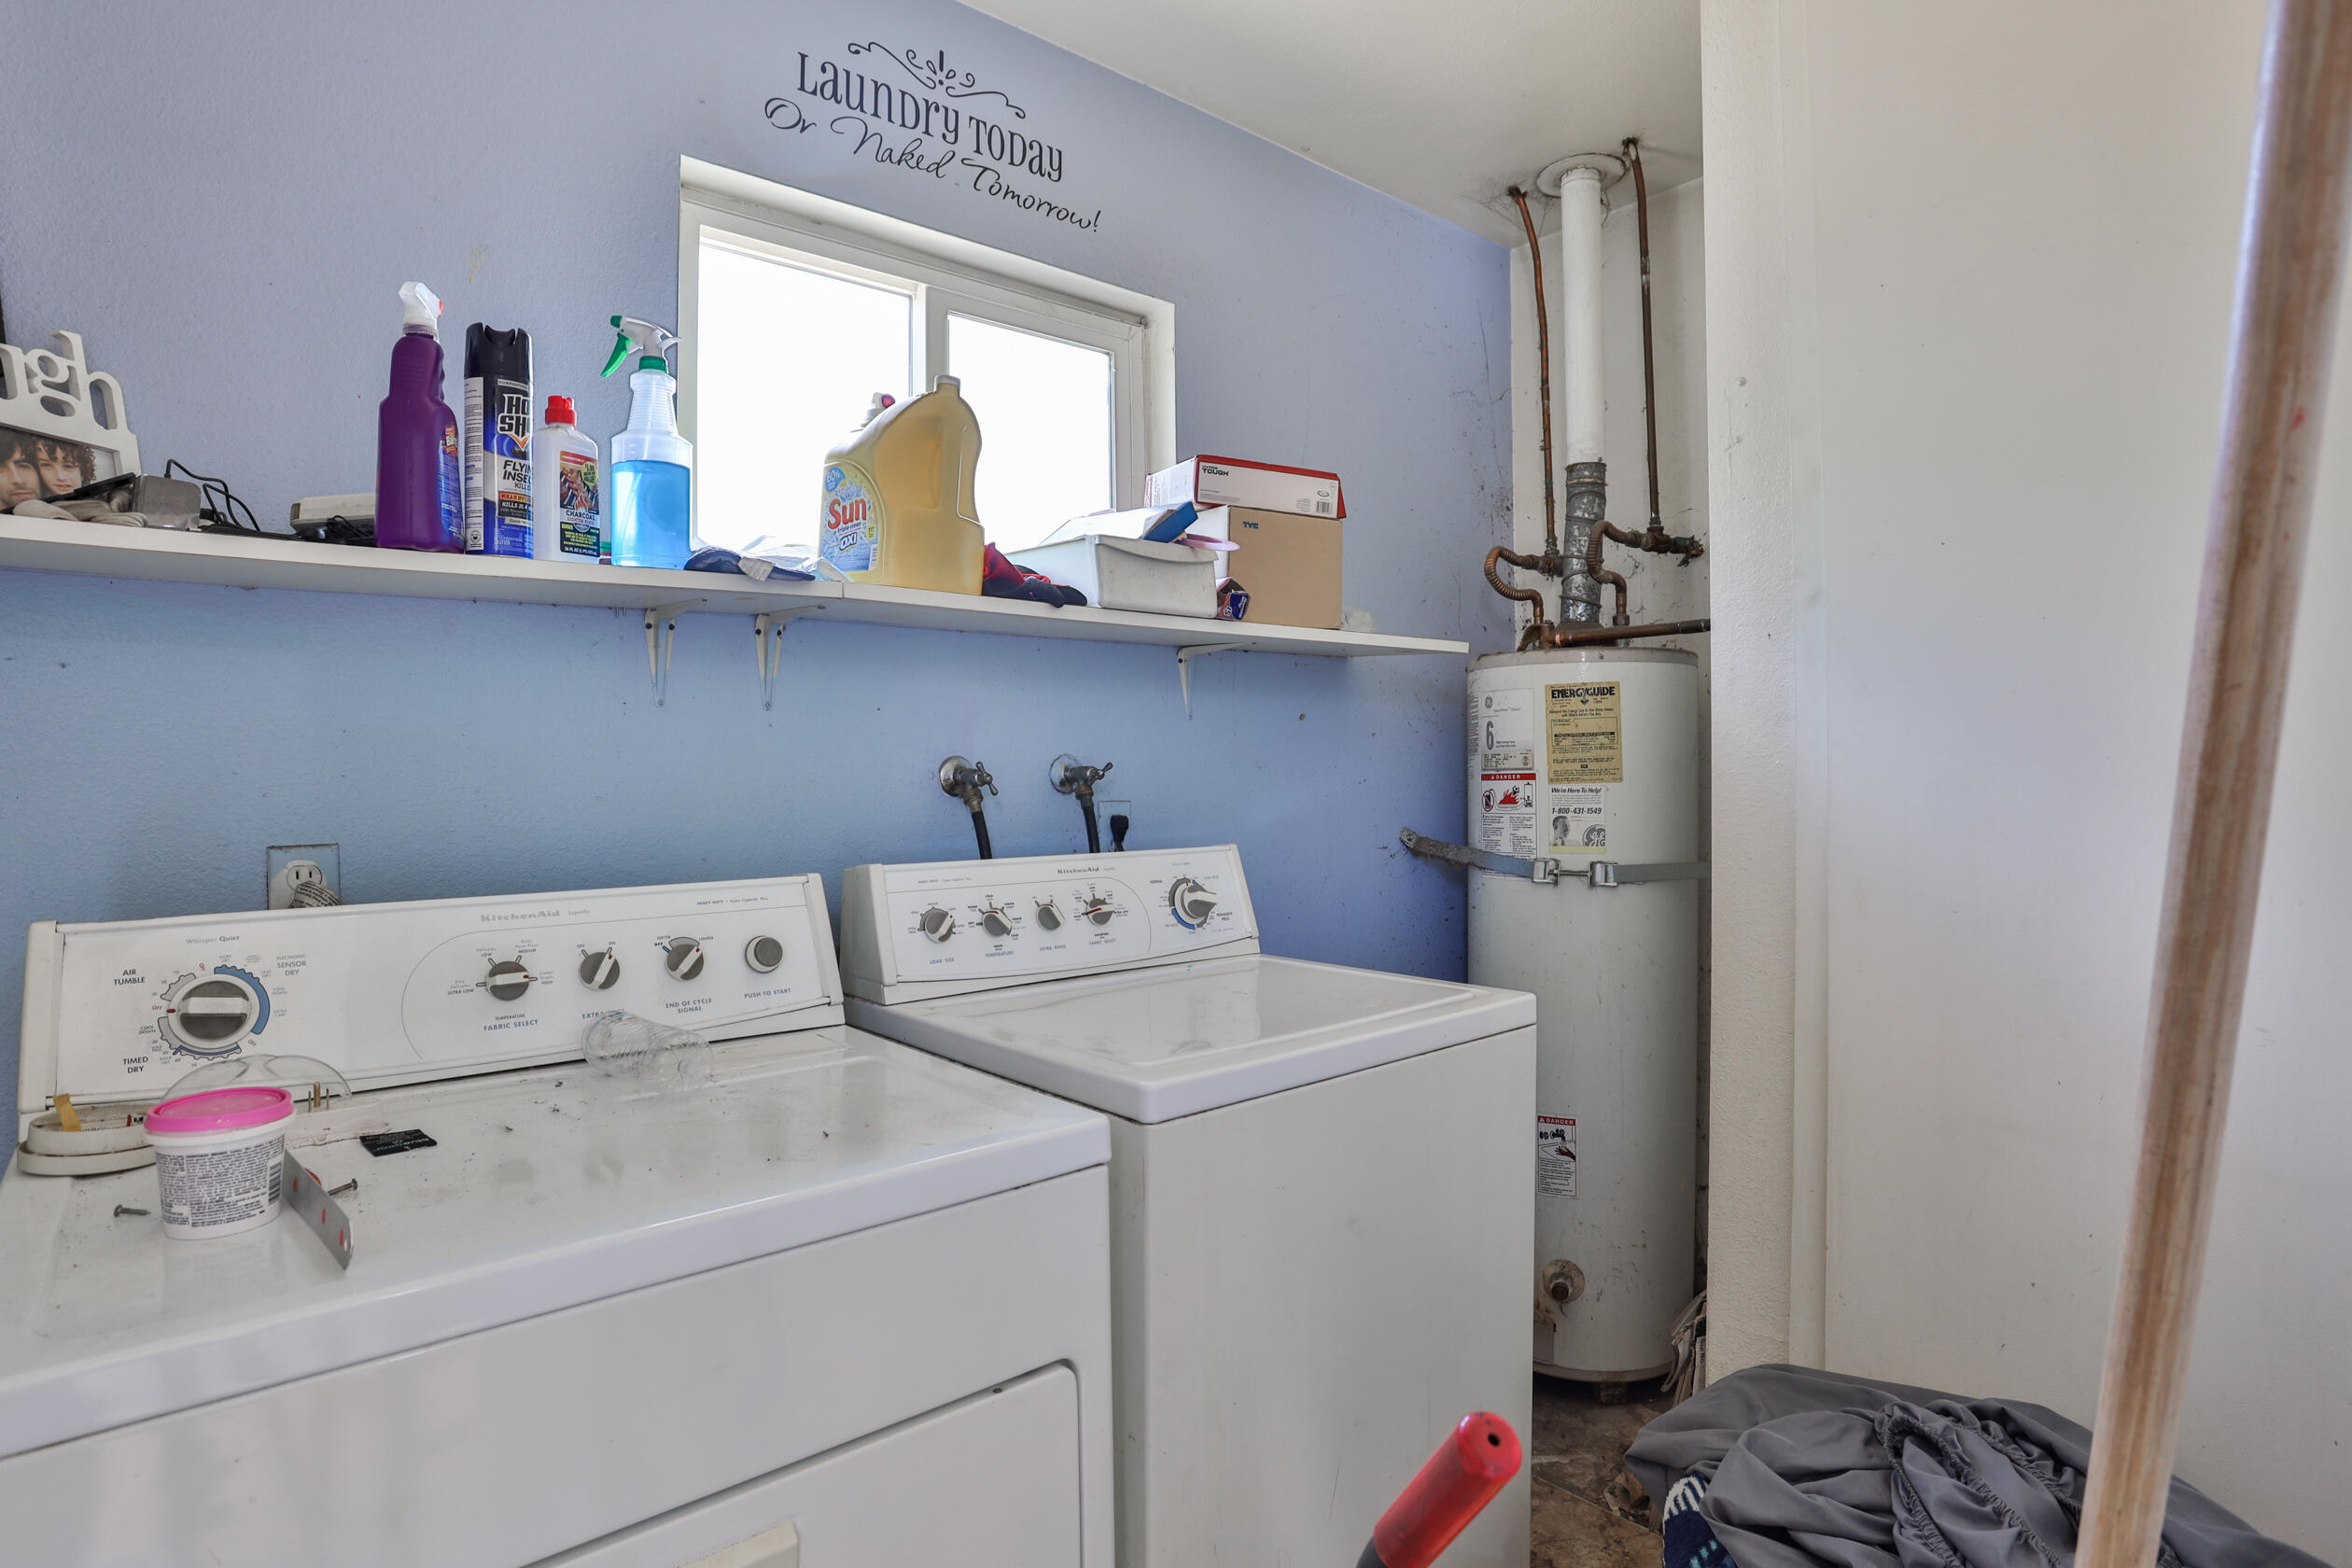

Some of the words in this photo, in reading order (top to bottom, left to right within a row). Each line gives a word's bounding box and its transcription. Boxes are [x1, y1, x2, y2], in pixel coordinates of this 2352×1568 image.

[764, 97, 817, 134] Or
[831, 116, 956, 179] Naked
[960, 158, 1101, 232] Tomorrow!
[505, 395, 531, 415] HO
[497, 413, 531, 440] SH
[828, 497, 867, 530] Sun
[840, 532, 858, 550] OXI
[1486, 721, 1494, 750] 6
[481, 910, 560, 922] KitchenAid
[186, 936, 217, 945] Whisper
[218, 934, 240, 943] Quiet
[276, 959, 307, 969] SENSOR
[114, 976, 146, 986] TUMBLE
[773, 987, 791, 996] START
[665, 1001, 680, 1009] END
[483, 1021, 511, 1031] FABRIC
[513, 1019, 539, 1028] SELECT
[123, 1056, 148, 1065] TIMED
[127, 1066, 145, 1074] DRY
